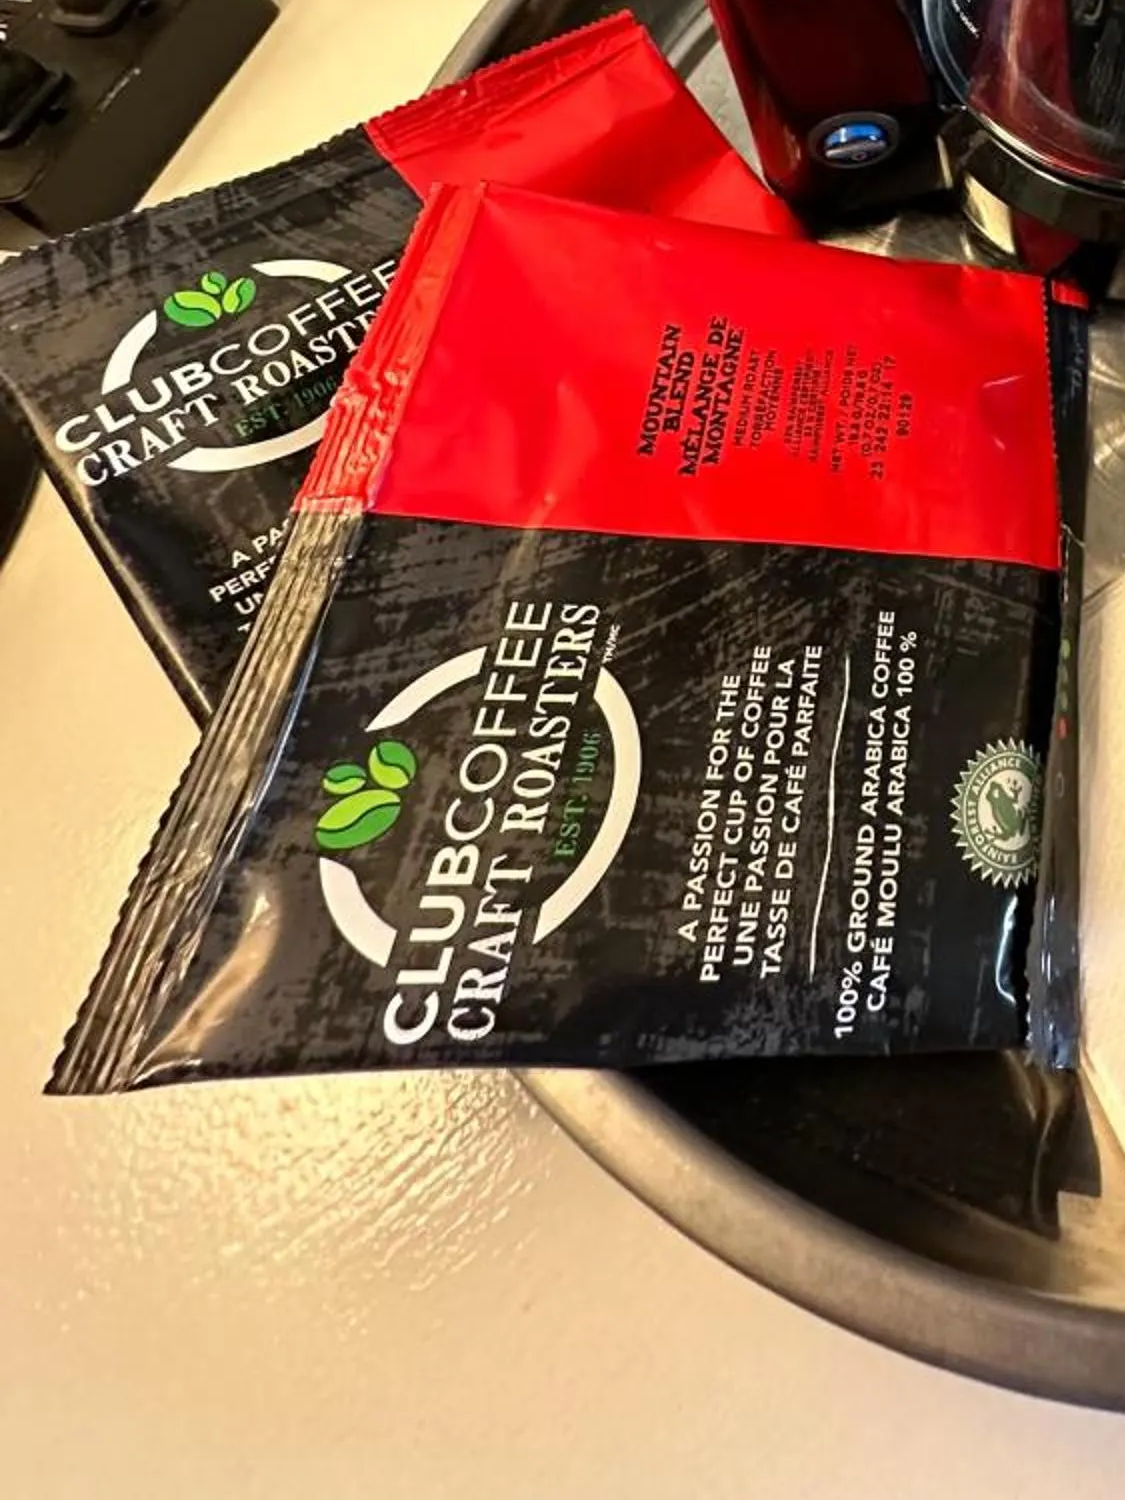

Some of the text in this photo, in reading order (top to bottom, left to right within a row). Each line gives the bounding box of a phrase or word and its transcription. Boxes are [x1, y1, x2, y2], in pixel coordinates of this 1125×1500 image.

[76, 310, 377, 487] CRAFT ROAST
[637, 323, 681, 456] MOUNTAIN
[663, 351, 694, 432] BLEND
[678, 315, 727, 476] MÉLANGE DE
[701, 327, 743, 464] MONTAGNE
[209, 555, 276, 602] PERF
[232, 550, 251, 568] A
[383, 601, 552, 1044] CLUBCOFFEE
[447, 604, 600, 1041] CRAFT ROASTERS
[677, 675, 741, 942] A PASSION FOR THE
[699, 645, 771, 981] PERFECT CUP OF COFFEE
[732, 658, 795, 966] UNE PASSION POUR LA
[760, 645, 823, 979] TASSE DE CAFÉ PARFAITE
[834, 611, 895, 1039] 100% GROUND ARABICA COFFEE
[867, 631, 917, 1012] CAFÉ MOULU ARABICA 100 %
[971, 757, 1022, 796] ALLIANCE
